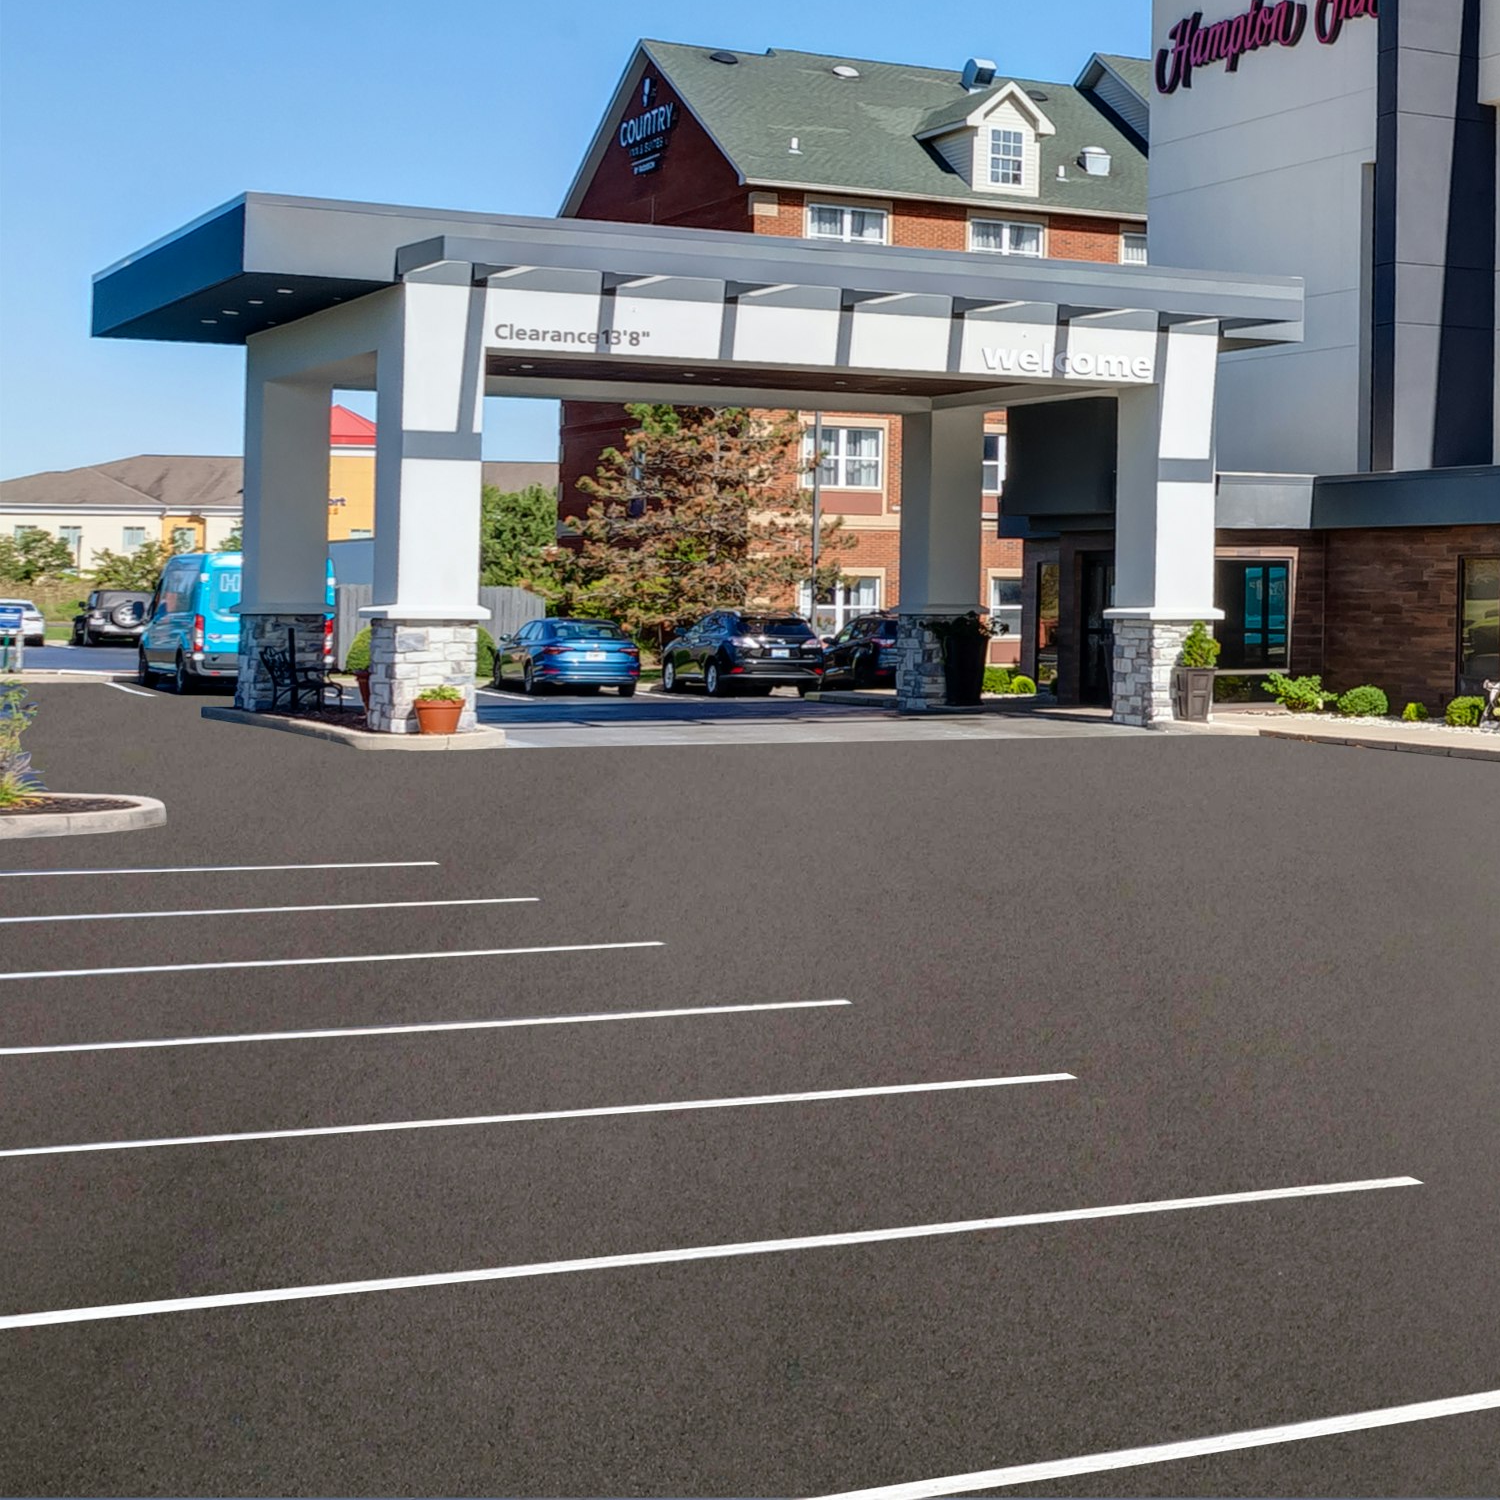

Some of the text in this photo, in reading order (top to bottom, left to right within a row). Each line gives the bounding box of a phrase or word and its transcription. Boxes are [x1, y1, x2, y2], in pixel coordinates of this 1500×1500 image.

[1155, 11, 1307, 94] Hampton
[619, 102, 674, 148] COUNTRY
[494, 323, 651, 347] Clearance 13'8"
[982, 343, 1152, 379] welcome
